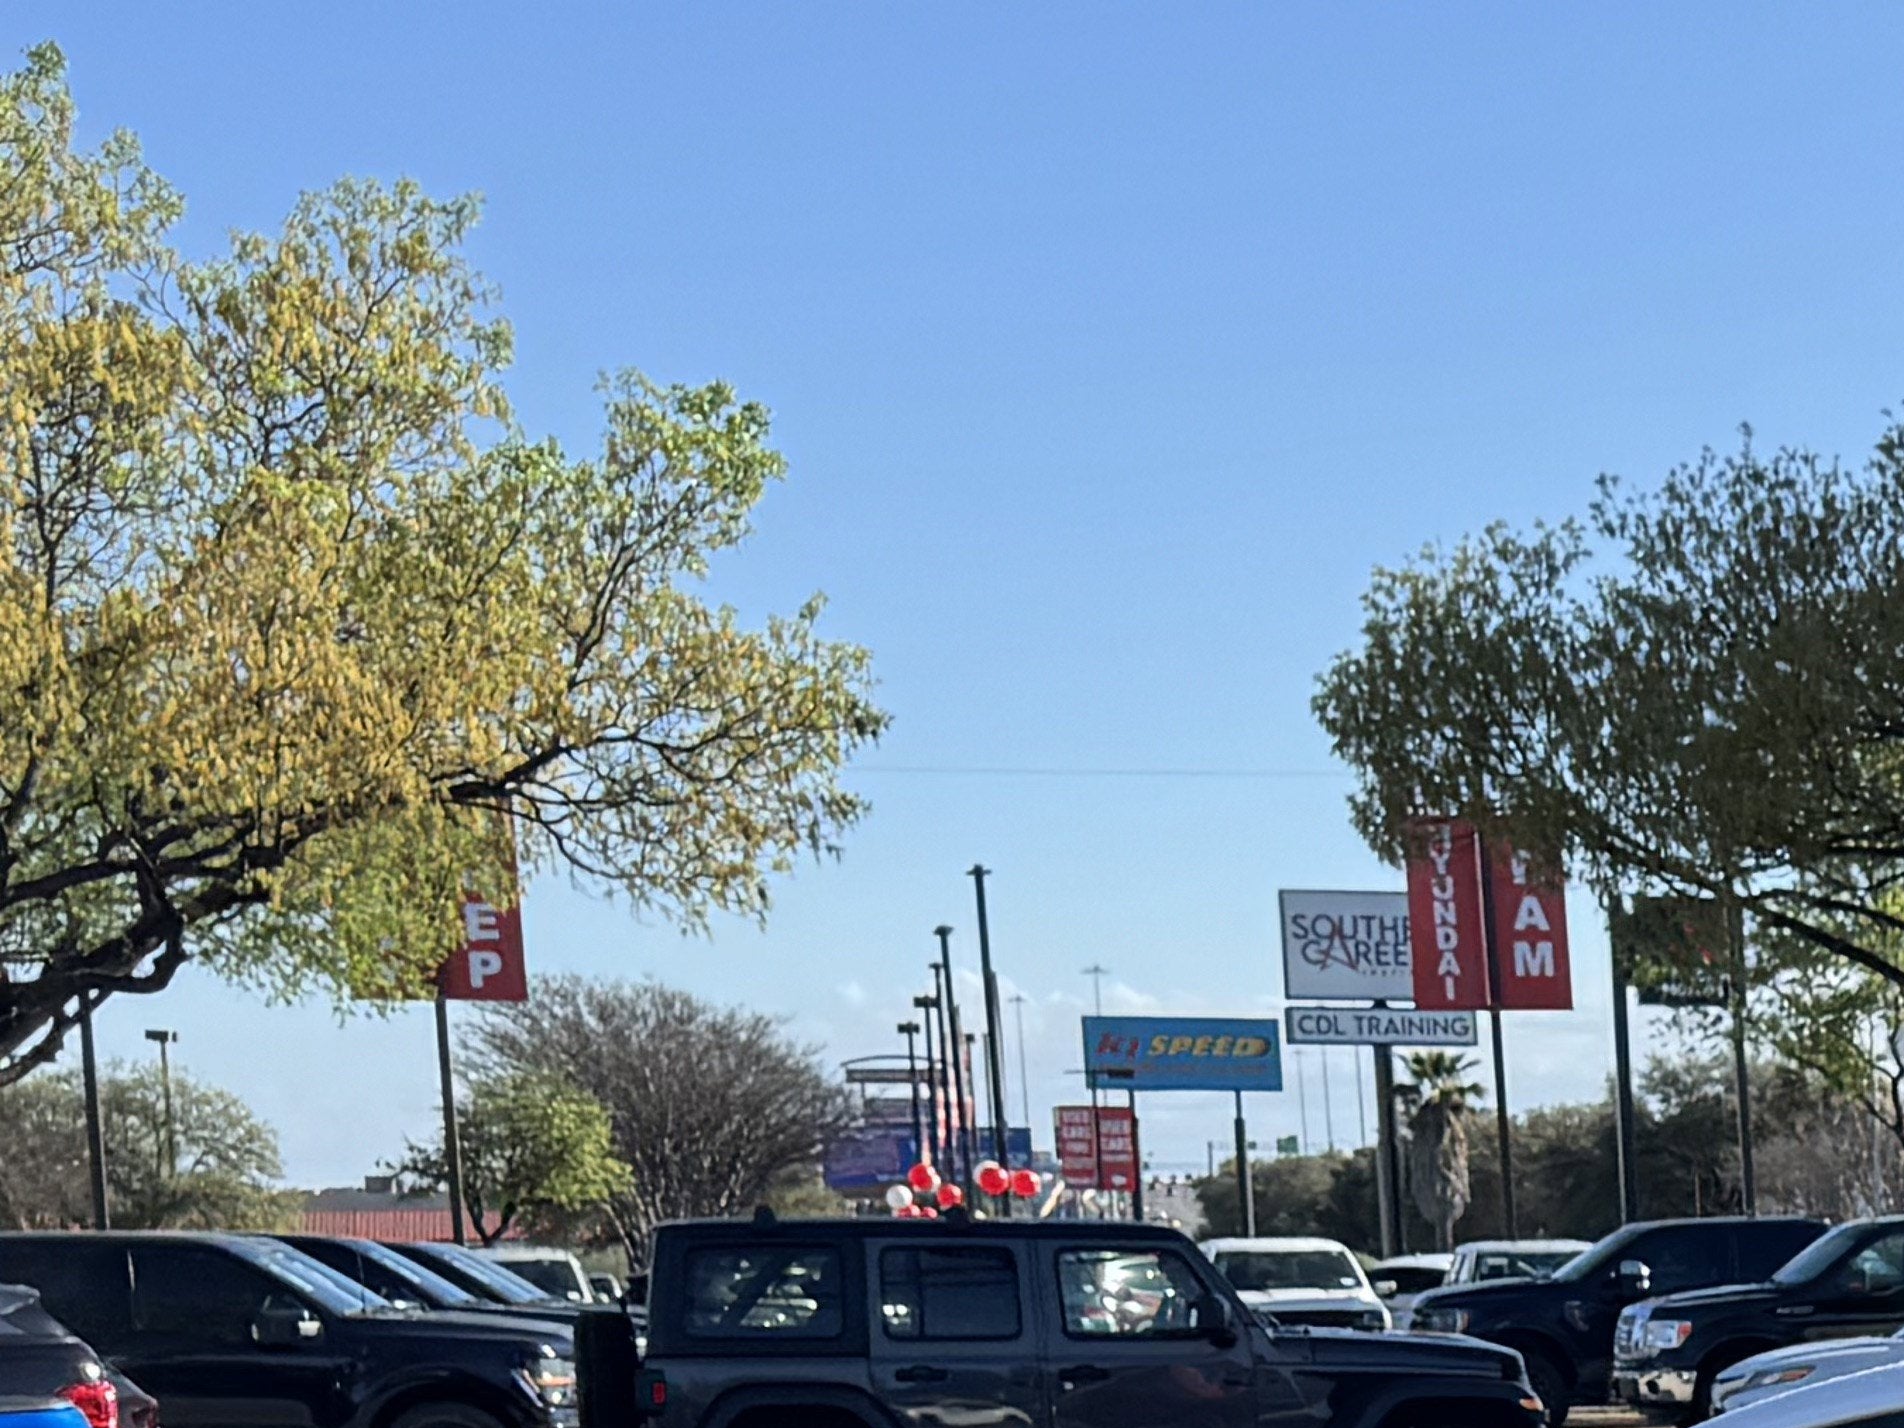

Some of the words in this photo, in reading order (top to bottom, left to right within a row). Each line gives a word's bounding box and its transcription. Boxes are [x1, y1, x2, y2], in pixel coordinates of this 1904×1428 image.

[1297, 1015, 1347, 1036] CDL
[1355, 1016, 1470, 1037] TRAINING
[1149, 1034, 1270, 1058] SPEED
